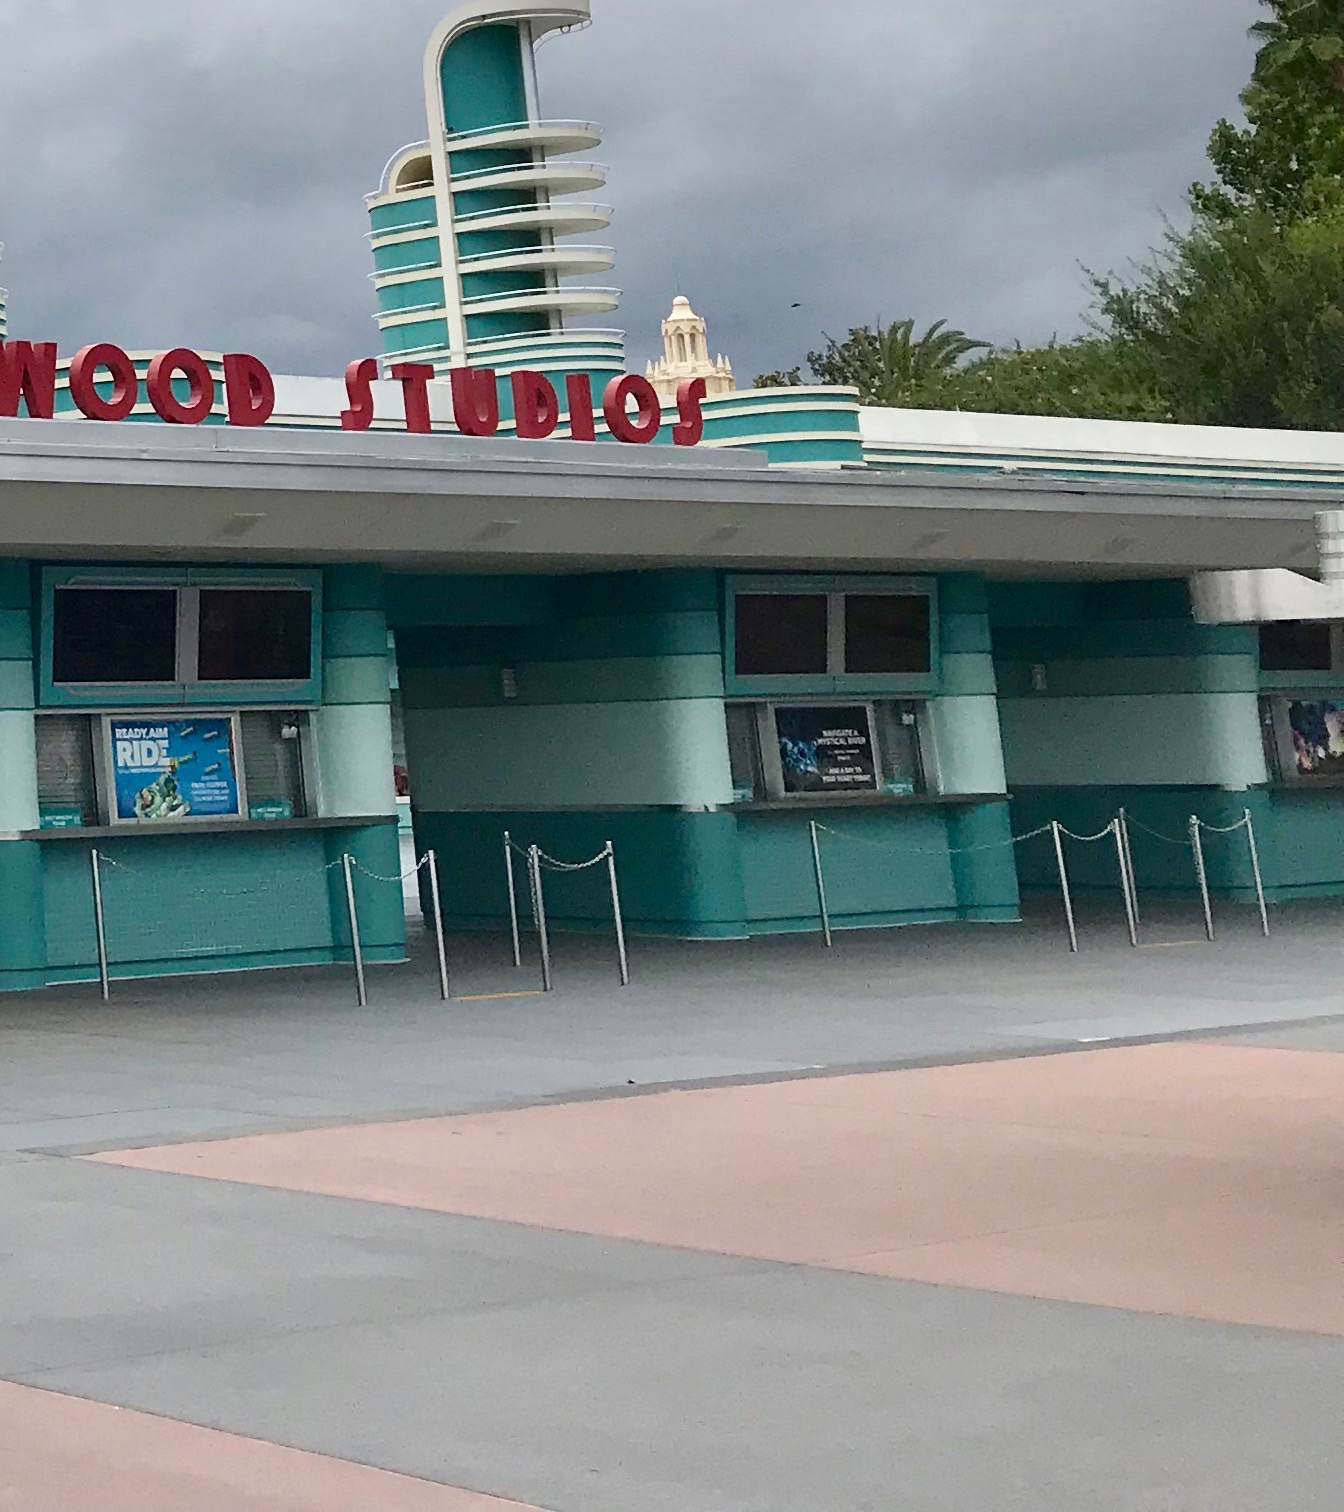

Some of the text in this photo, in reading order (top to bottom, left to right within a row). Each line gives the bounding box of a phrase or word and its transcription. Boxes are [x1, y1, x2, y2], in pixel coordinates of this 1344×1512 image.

[341, 358, 707, 446] STUDIOS
[115, 727, 169, 739] READY, AIM
[116, 739, 172, 767] RIDE
